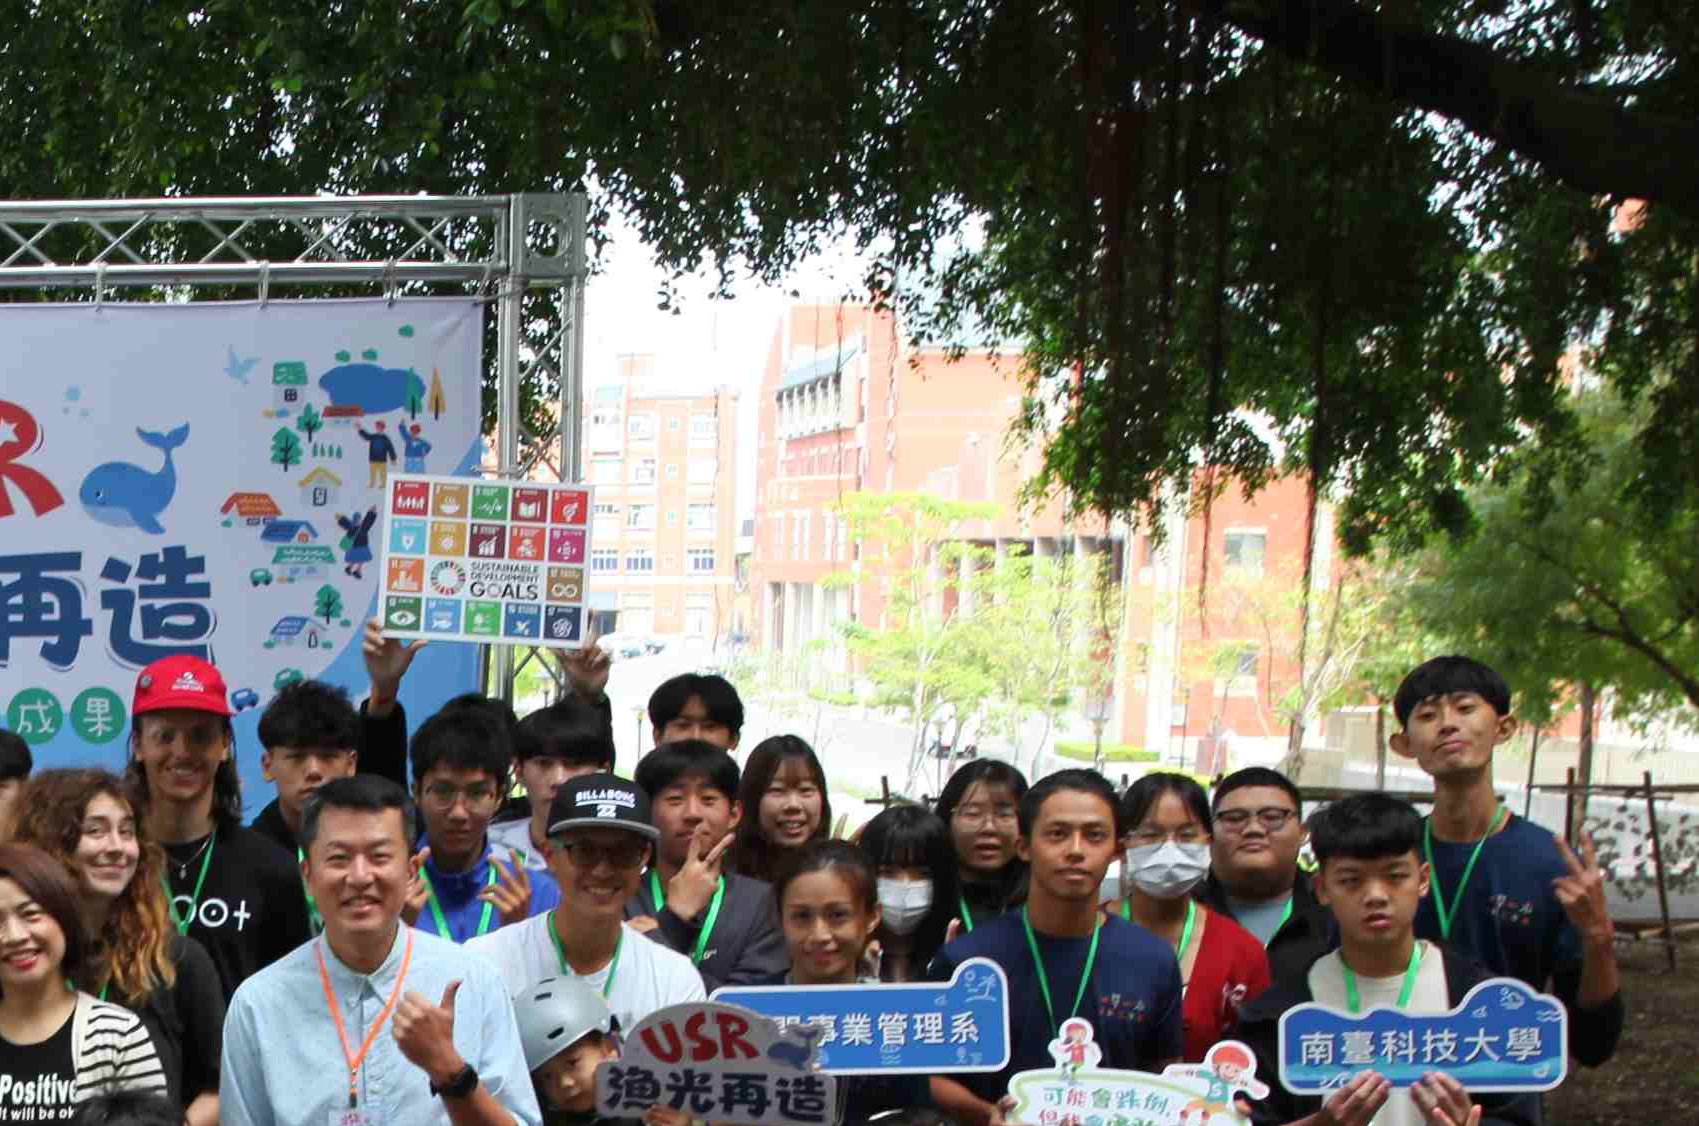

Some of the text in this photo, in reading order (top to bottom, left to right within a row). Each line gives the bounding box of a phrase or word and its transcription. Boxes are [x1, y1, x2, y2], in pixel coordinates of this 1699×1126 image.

[469, 581, 540, 601] GOALS
[574, 788, 637, 803] BILLABONG
[639, 1009, 761, 1065] USR
[1299, 1026, 1543, 1066] 南臺科技大學
[605, 1064, 827, 1123] 漁光再造
[10, 1107, 35, 1121] will
[38, 1107, 55, 1120] be
